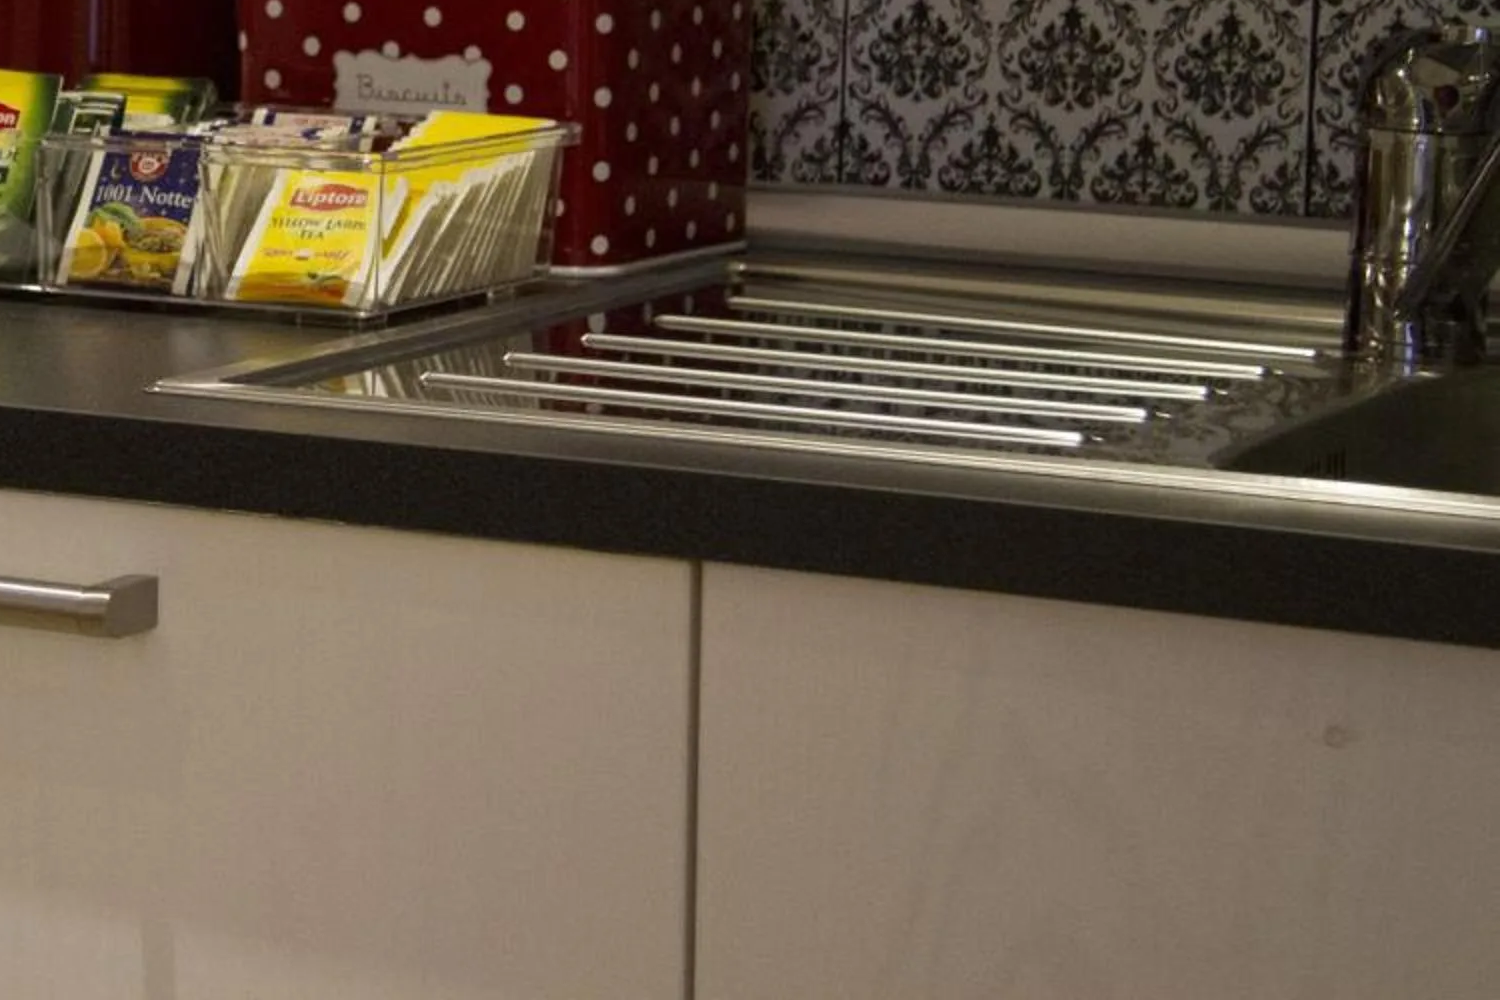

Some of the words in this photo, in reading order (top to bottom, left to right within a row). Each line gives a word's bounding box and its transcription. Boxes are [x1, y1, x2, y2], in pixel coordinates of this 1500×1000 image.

[96, 184, 133, 202] 1001
[139, 186, 194, 209] Notte
[294, 188, 366, 207] Lipton
